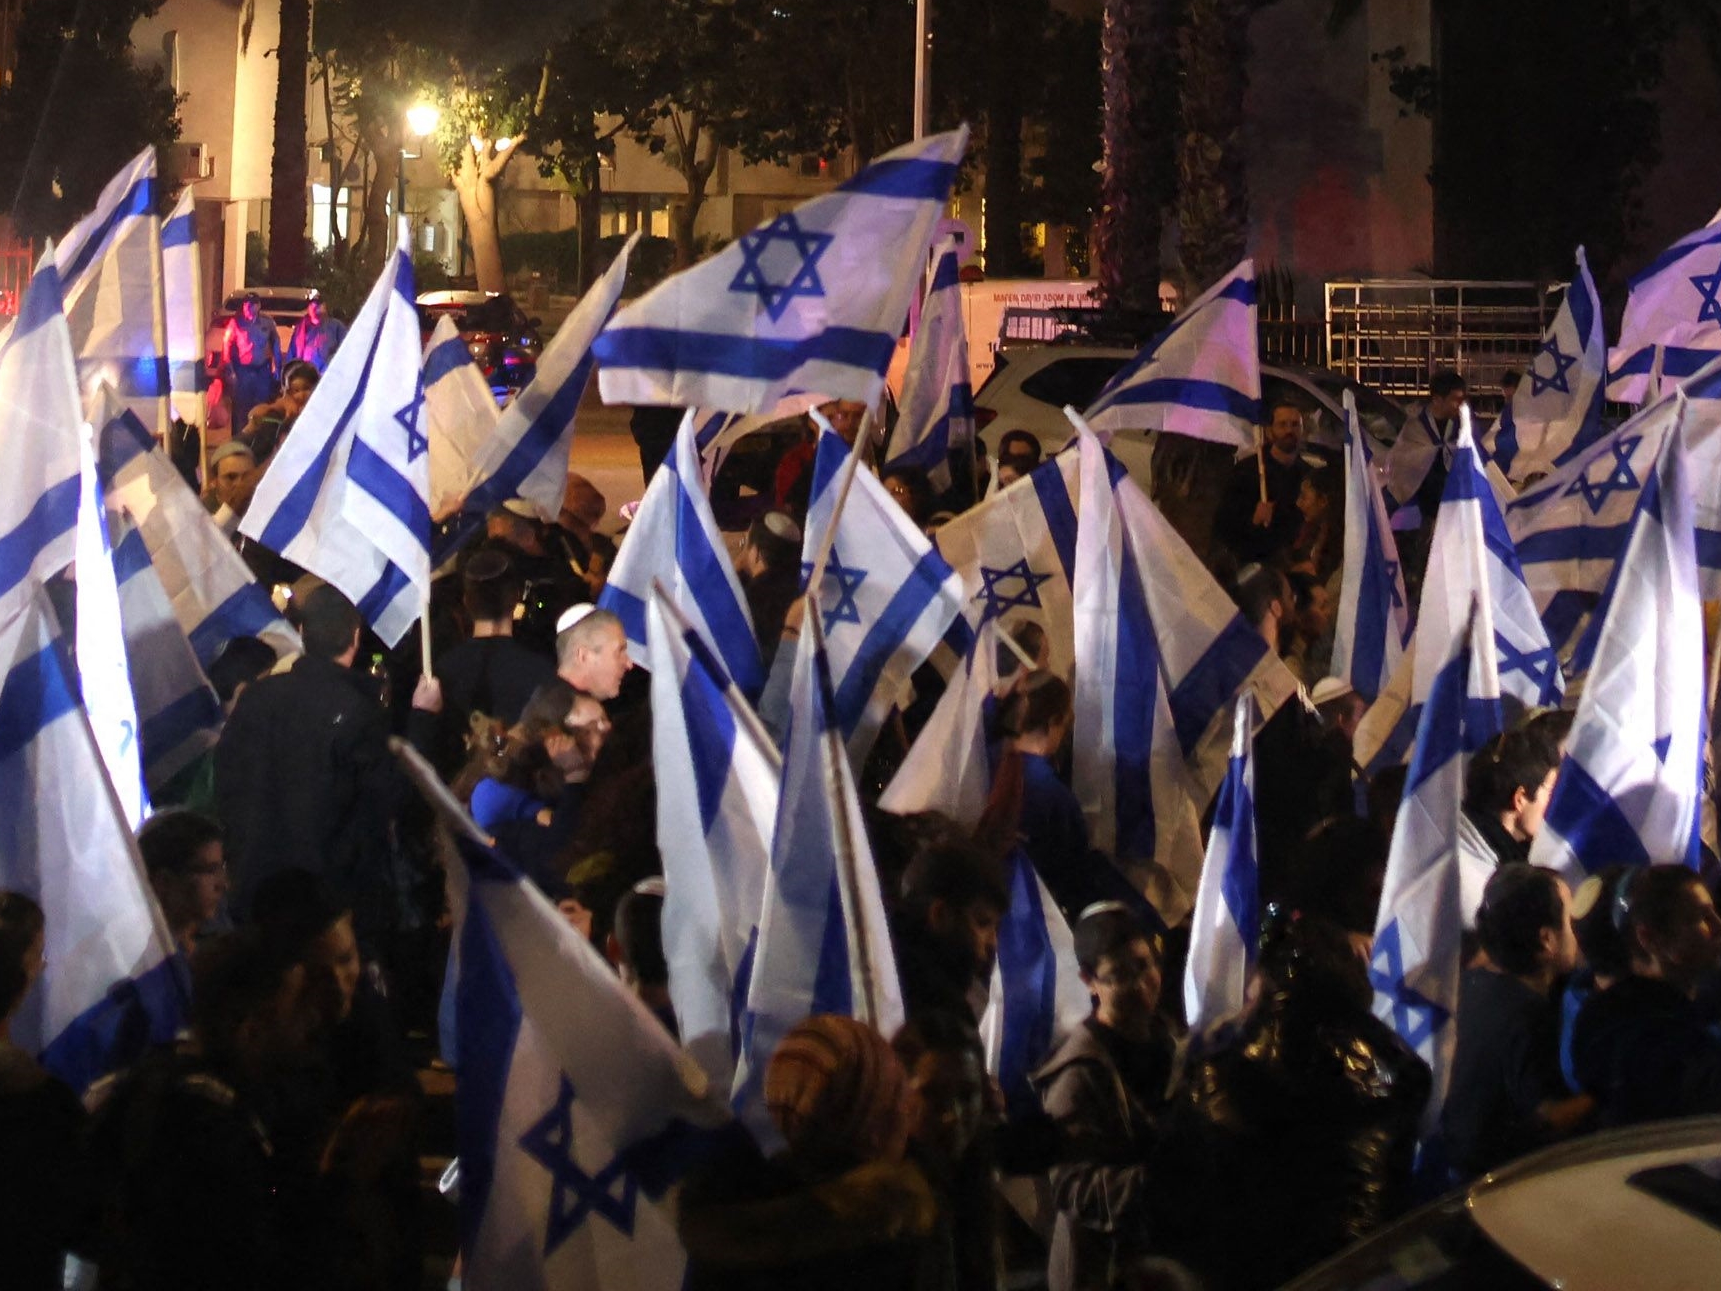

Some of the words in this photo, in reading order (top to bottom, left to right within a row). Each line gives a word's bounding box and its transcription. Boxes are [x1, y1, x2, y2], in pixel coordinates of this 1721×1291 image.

[1020, 293, 1041, 302] DAVID
[1043, 293, 1064, 302] ADOM
[1067, 293, 1075, 302] IN
